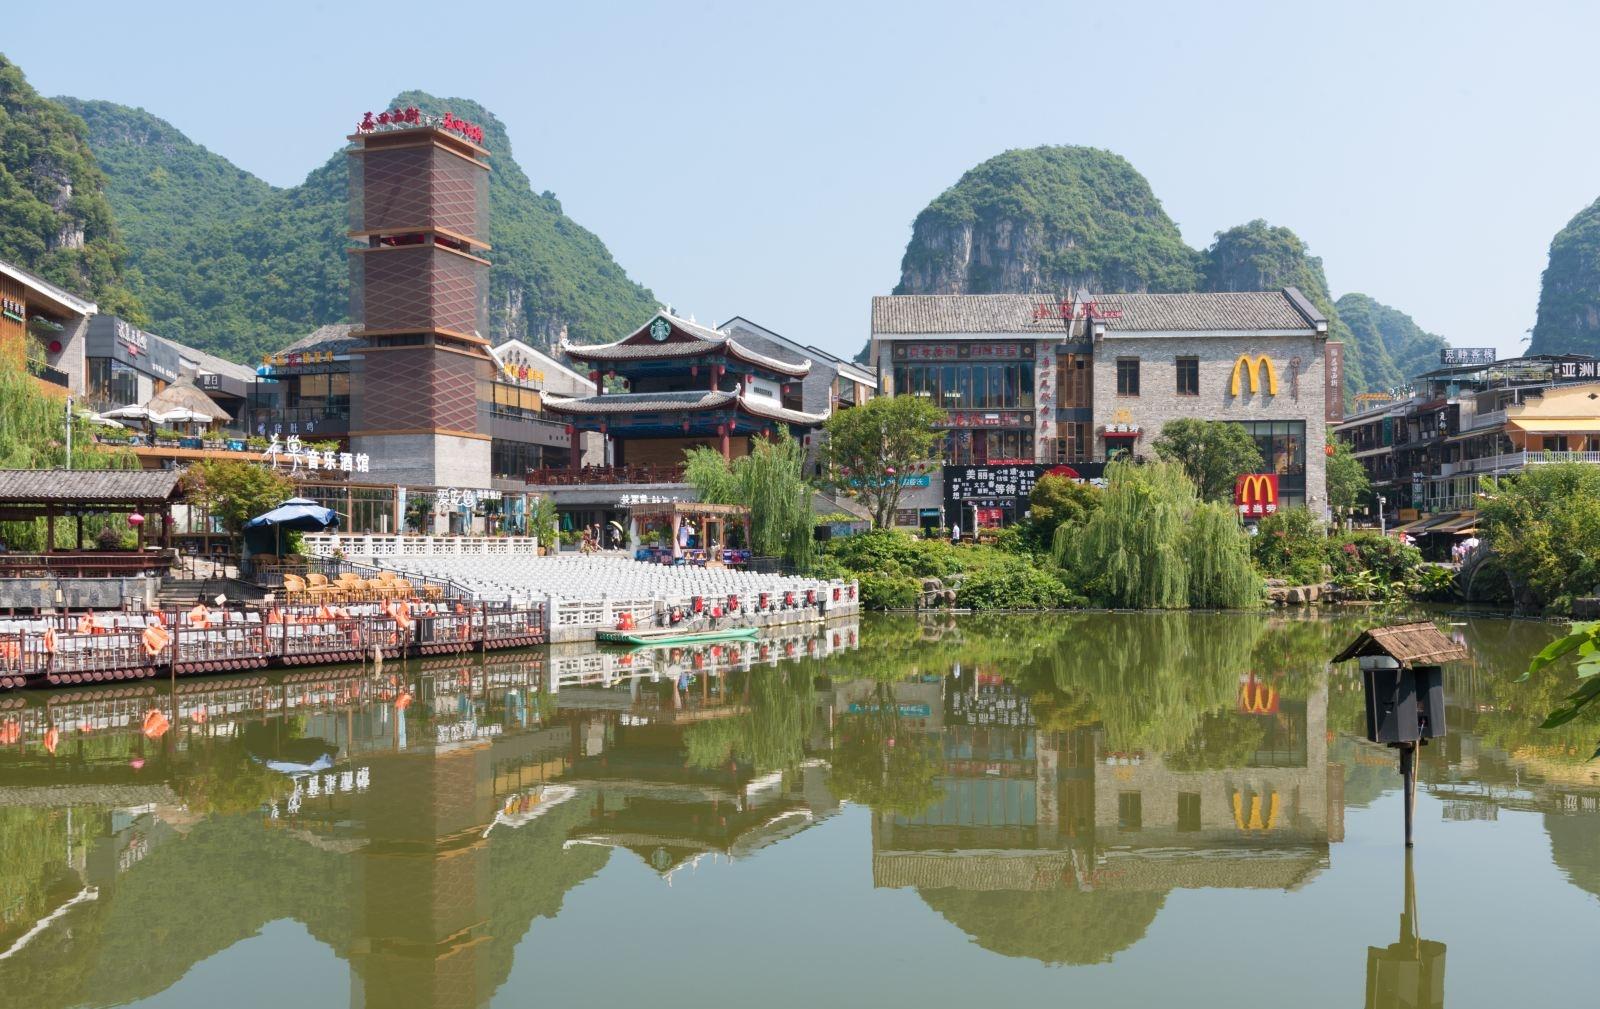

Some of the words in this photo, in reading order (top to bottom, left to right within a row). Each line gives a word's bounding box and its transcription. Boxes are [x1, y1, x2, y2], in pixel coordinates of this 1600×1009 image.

[1562, 362, 1600, 377] 亚洲
[1105, 424, 1139, 432] 麦当劳
[306, 449, 370, 472] 音乐酒馆
[966, 468, 989, 481] 美丽
[995, 483, 1016, 495] 等待
[1238, 504, 1277, 514] 麦当劳
